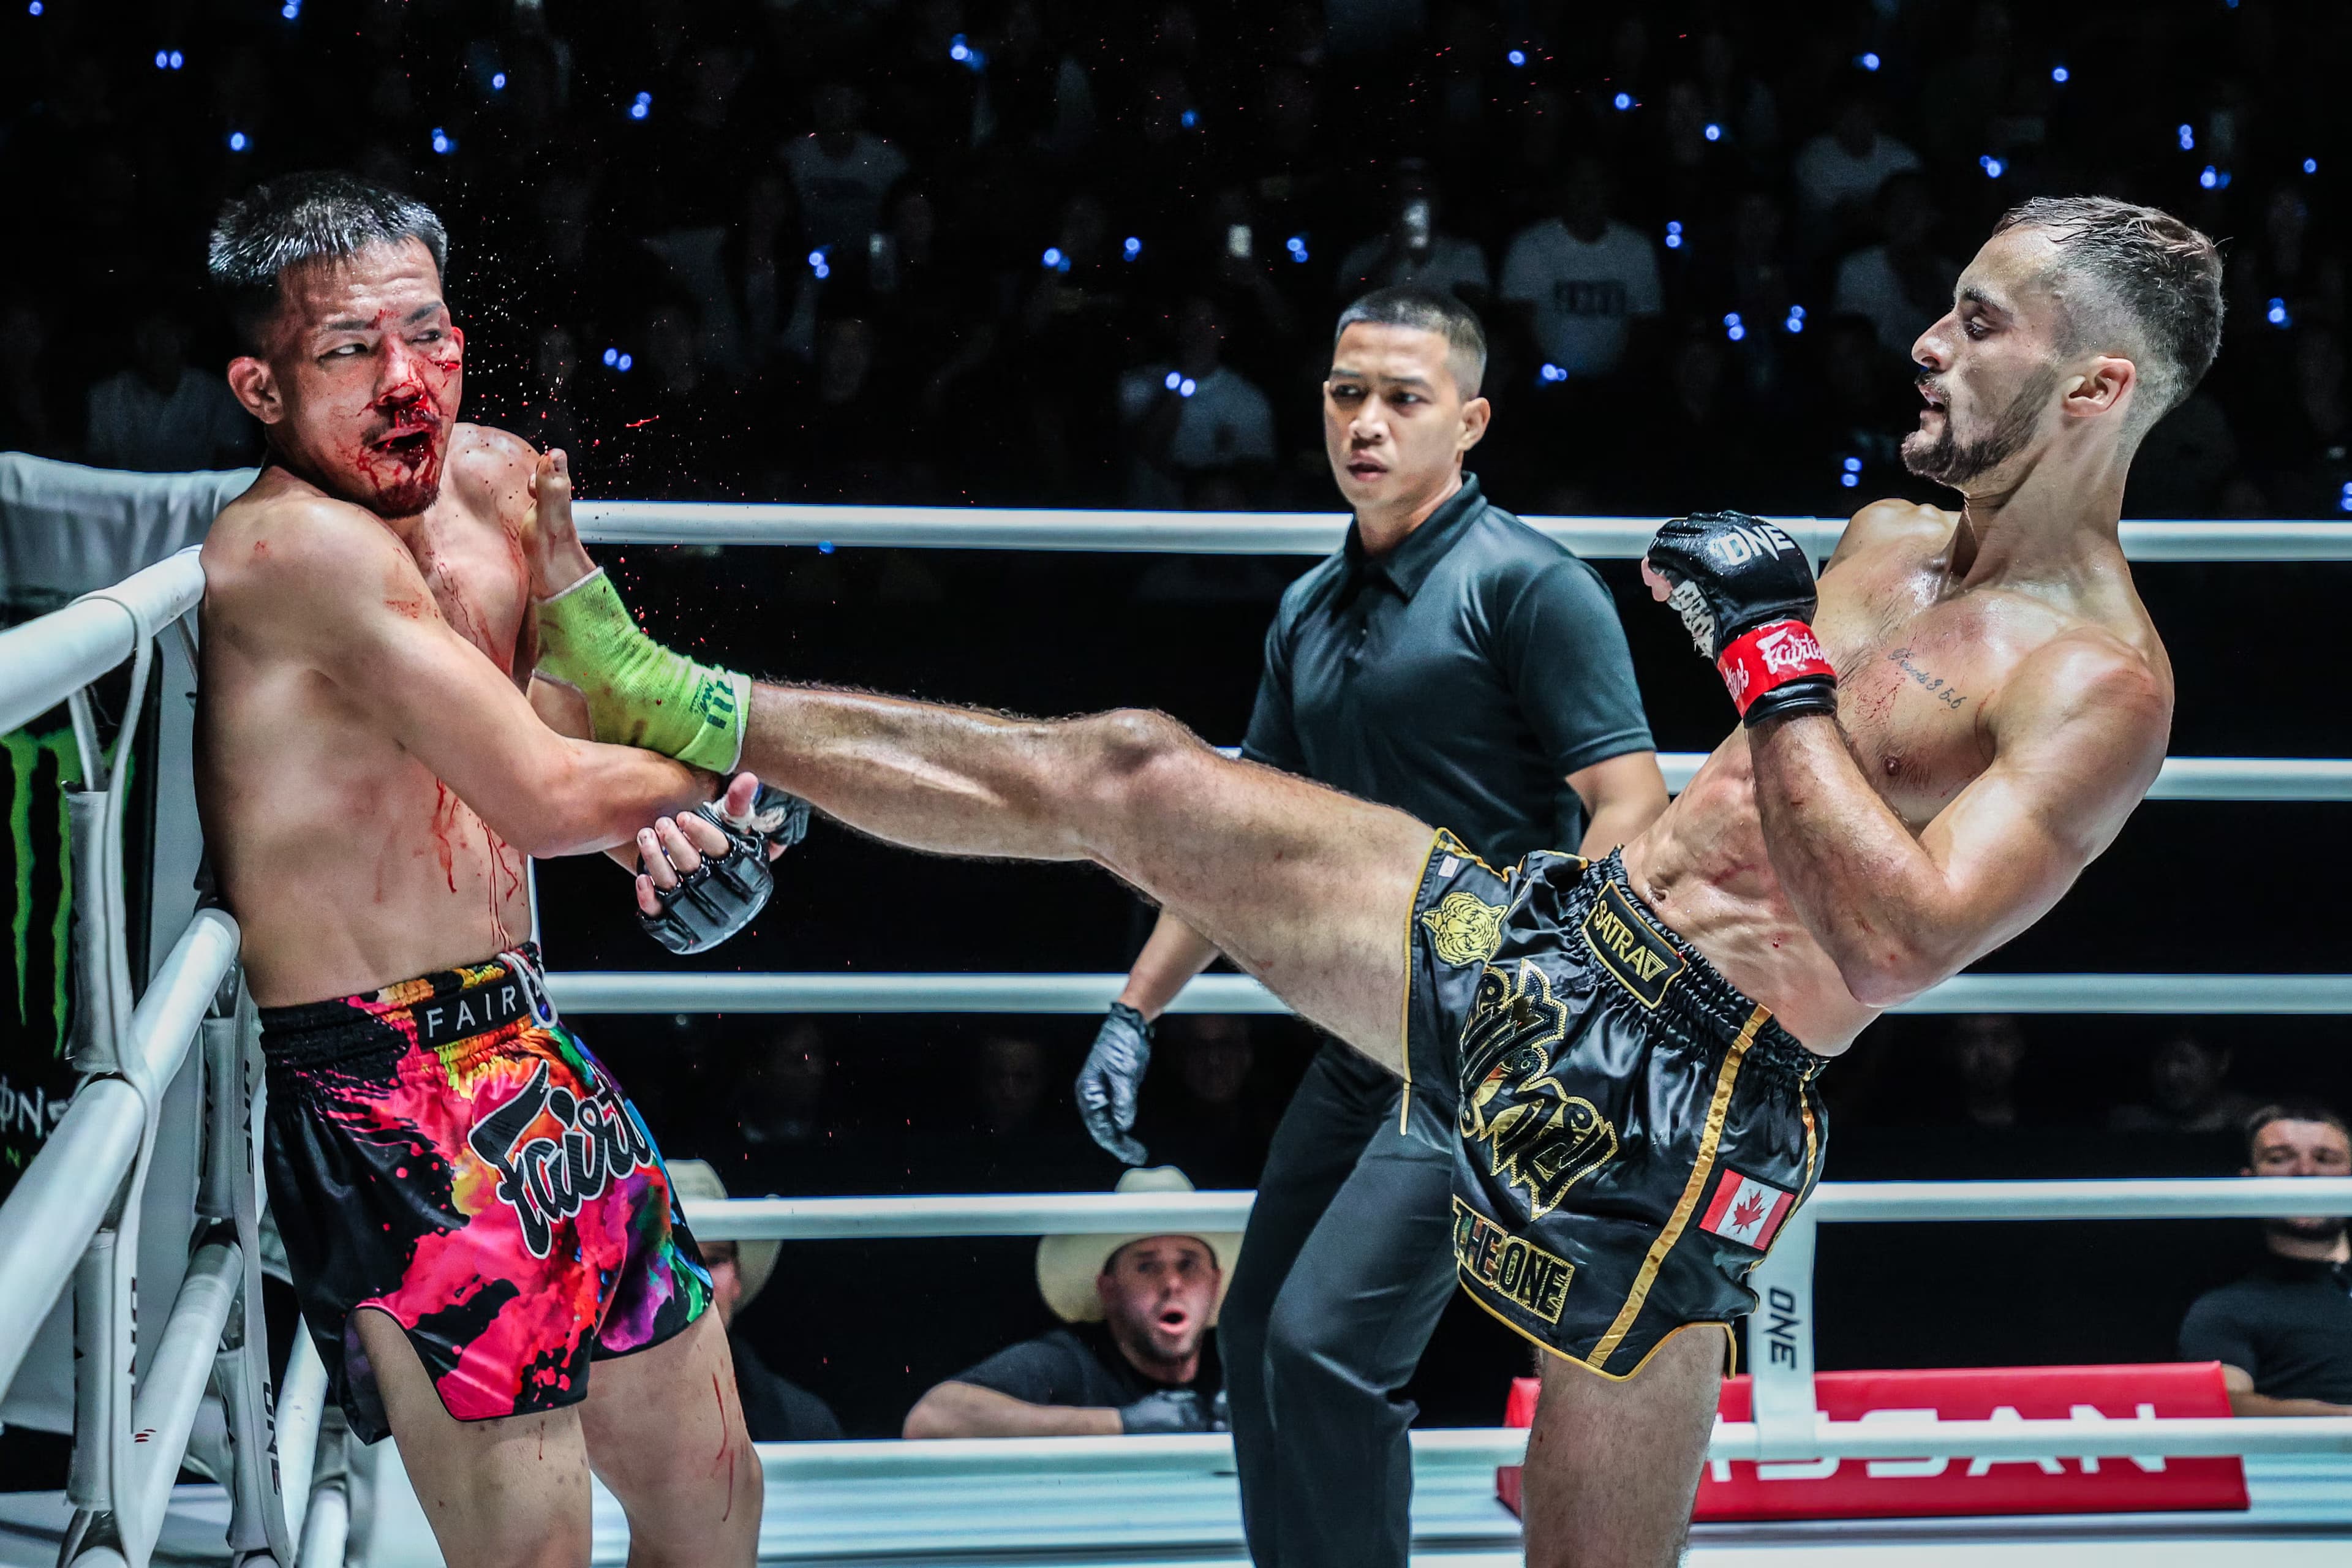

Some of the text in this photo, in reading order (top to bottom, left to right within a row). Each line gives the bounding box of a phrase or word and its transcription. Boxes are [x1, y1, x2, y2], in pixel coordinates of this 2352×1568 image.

[1719, 525, 1796, 566] ONE
[426, 983, 529, 1039] FAIR
[1454, 1199, 1568, 1317] THE ONE
[1763, 1287, 1802, 1370] ONE
